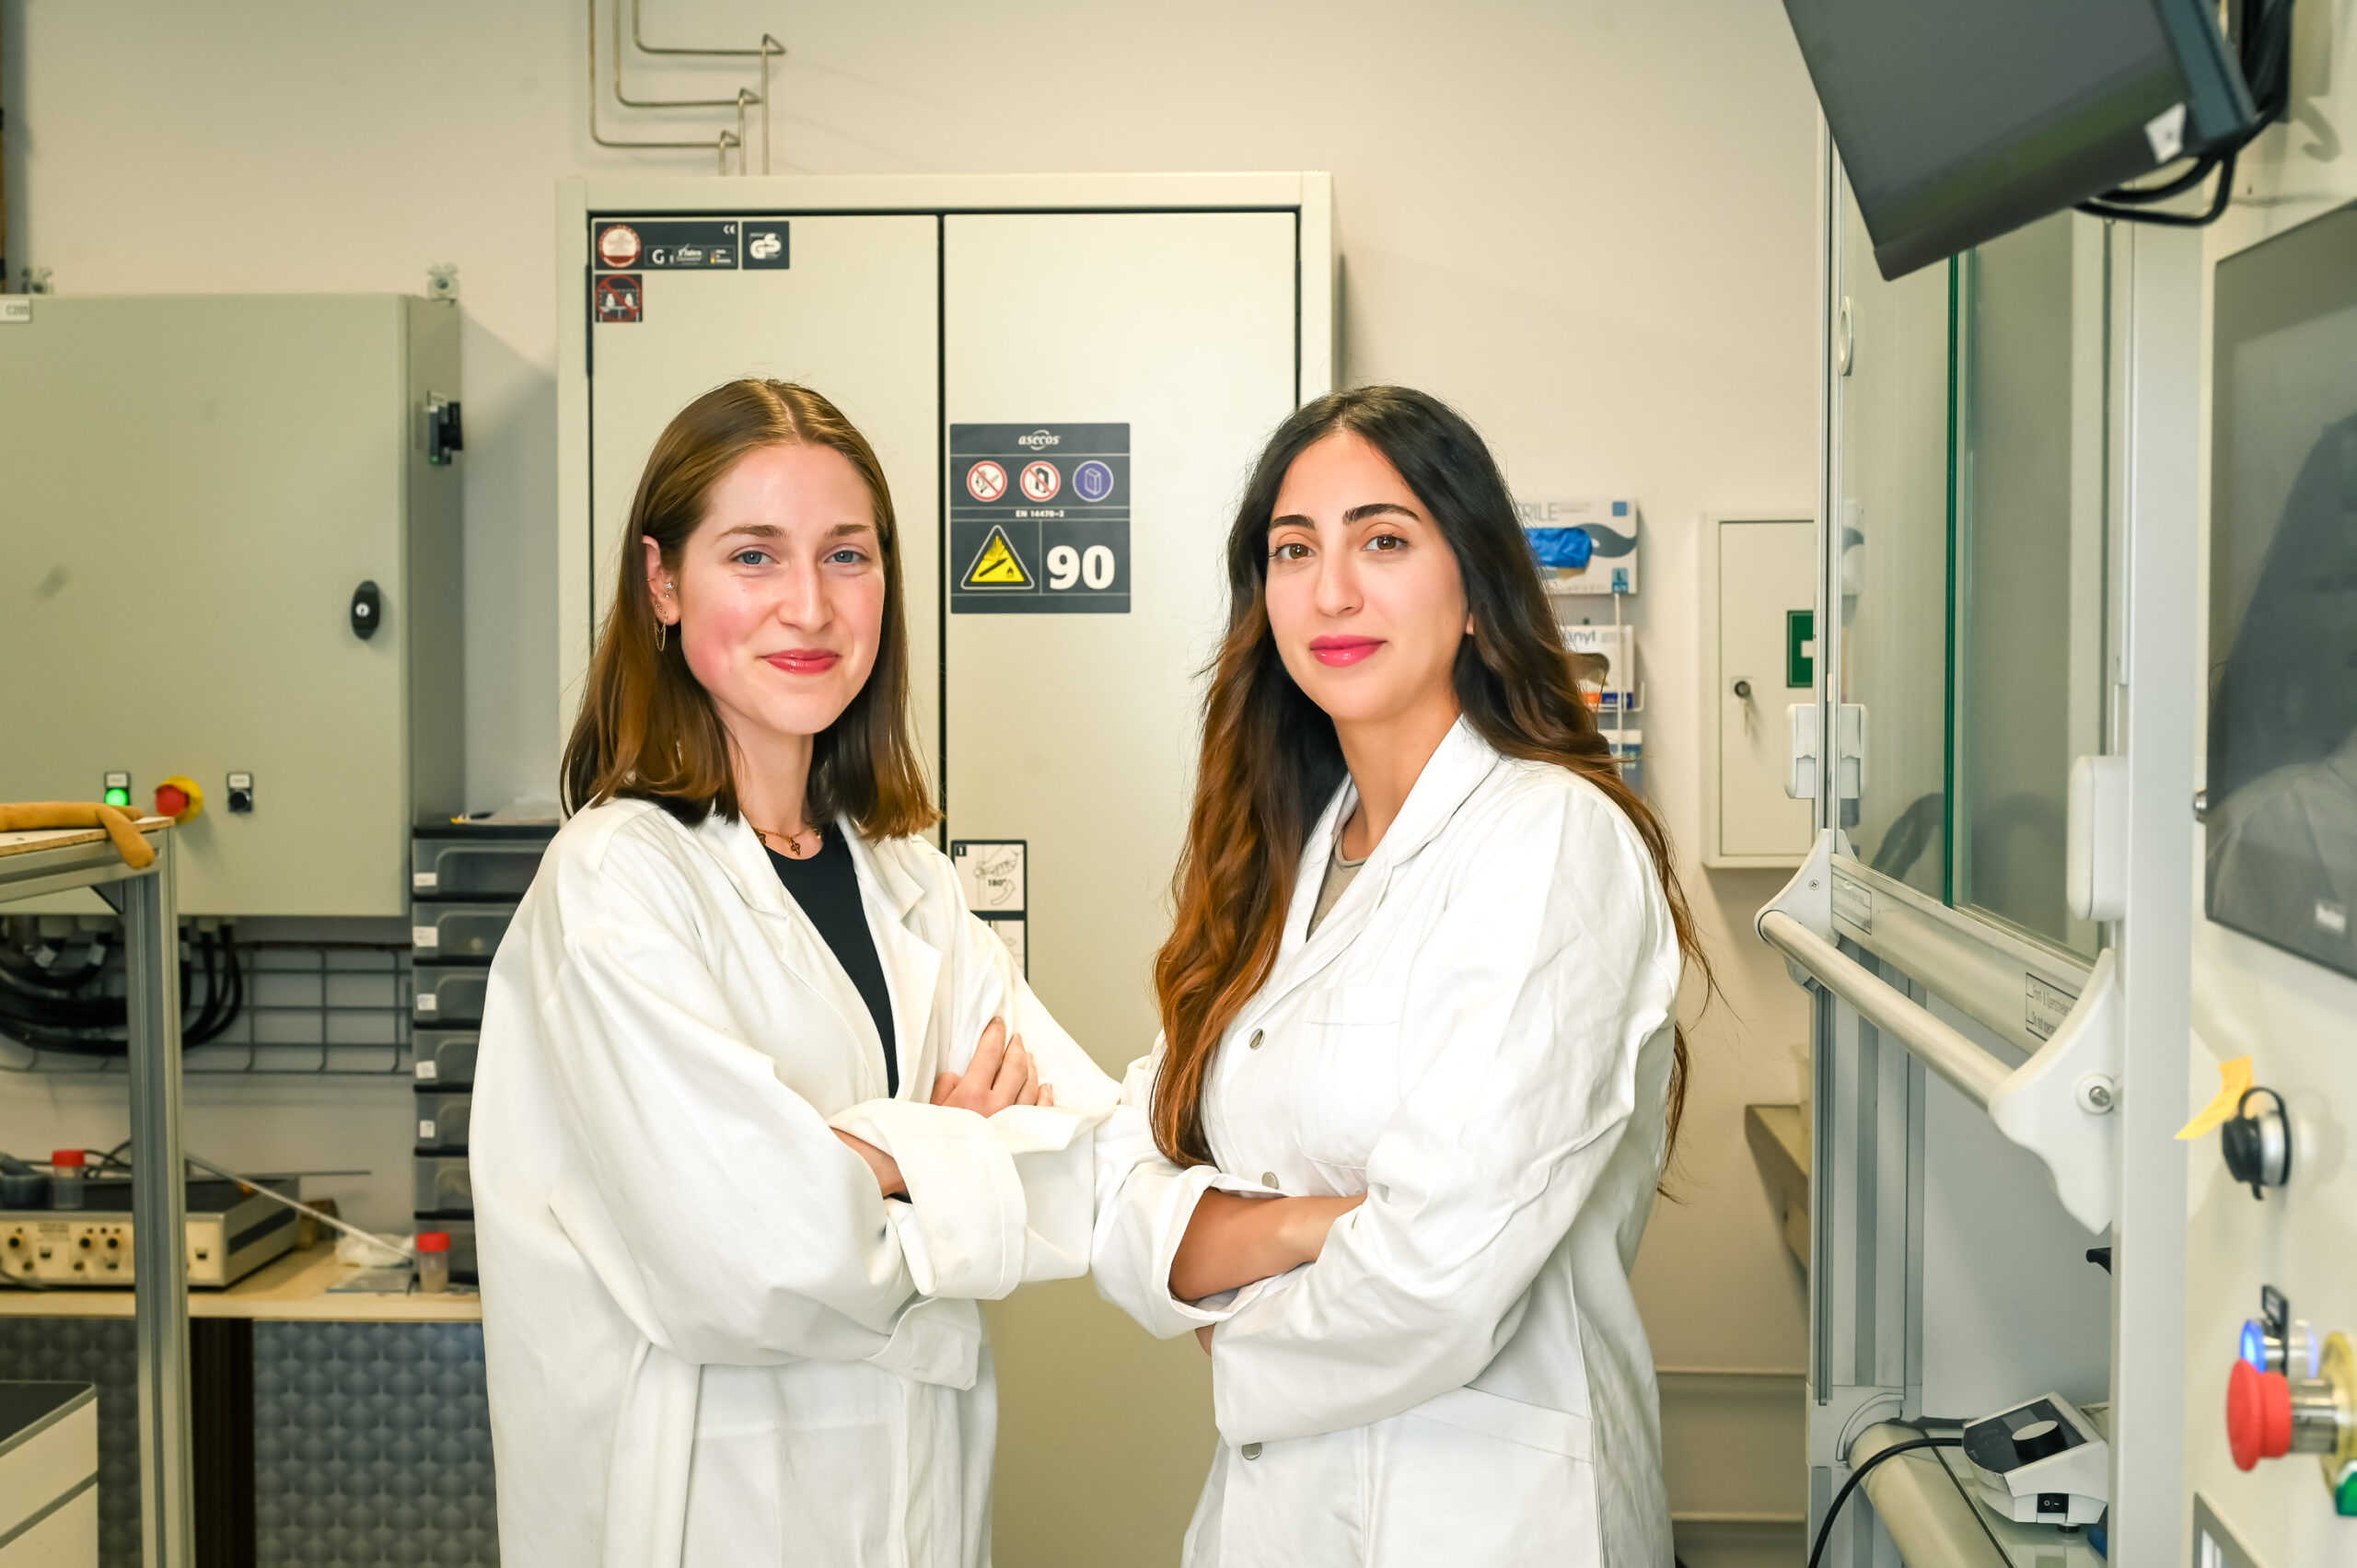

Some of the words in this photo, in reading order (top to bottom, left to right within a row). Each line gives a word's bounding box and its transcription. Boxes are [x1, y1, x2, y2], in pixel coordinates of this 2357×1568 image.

[1017, 435, 1060, 446] asecos
[1016, 510, 1028, 518] EN
[1046, 544, 1115, 590] 90
